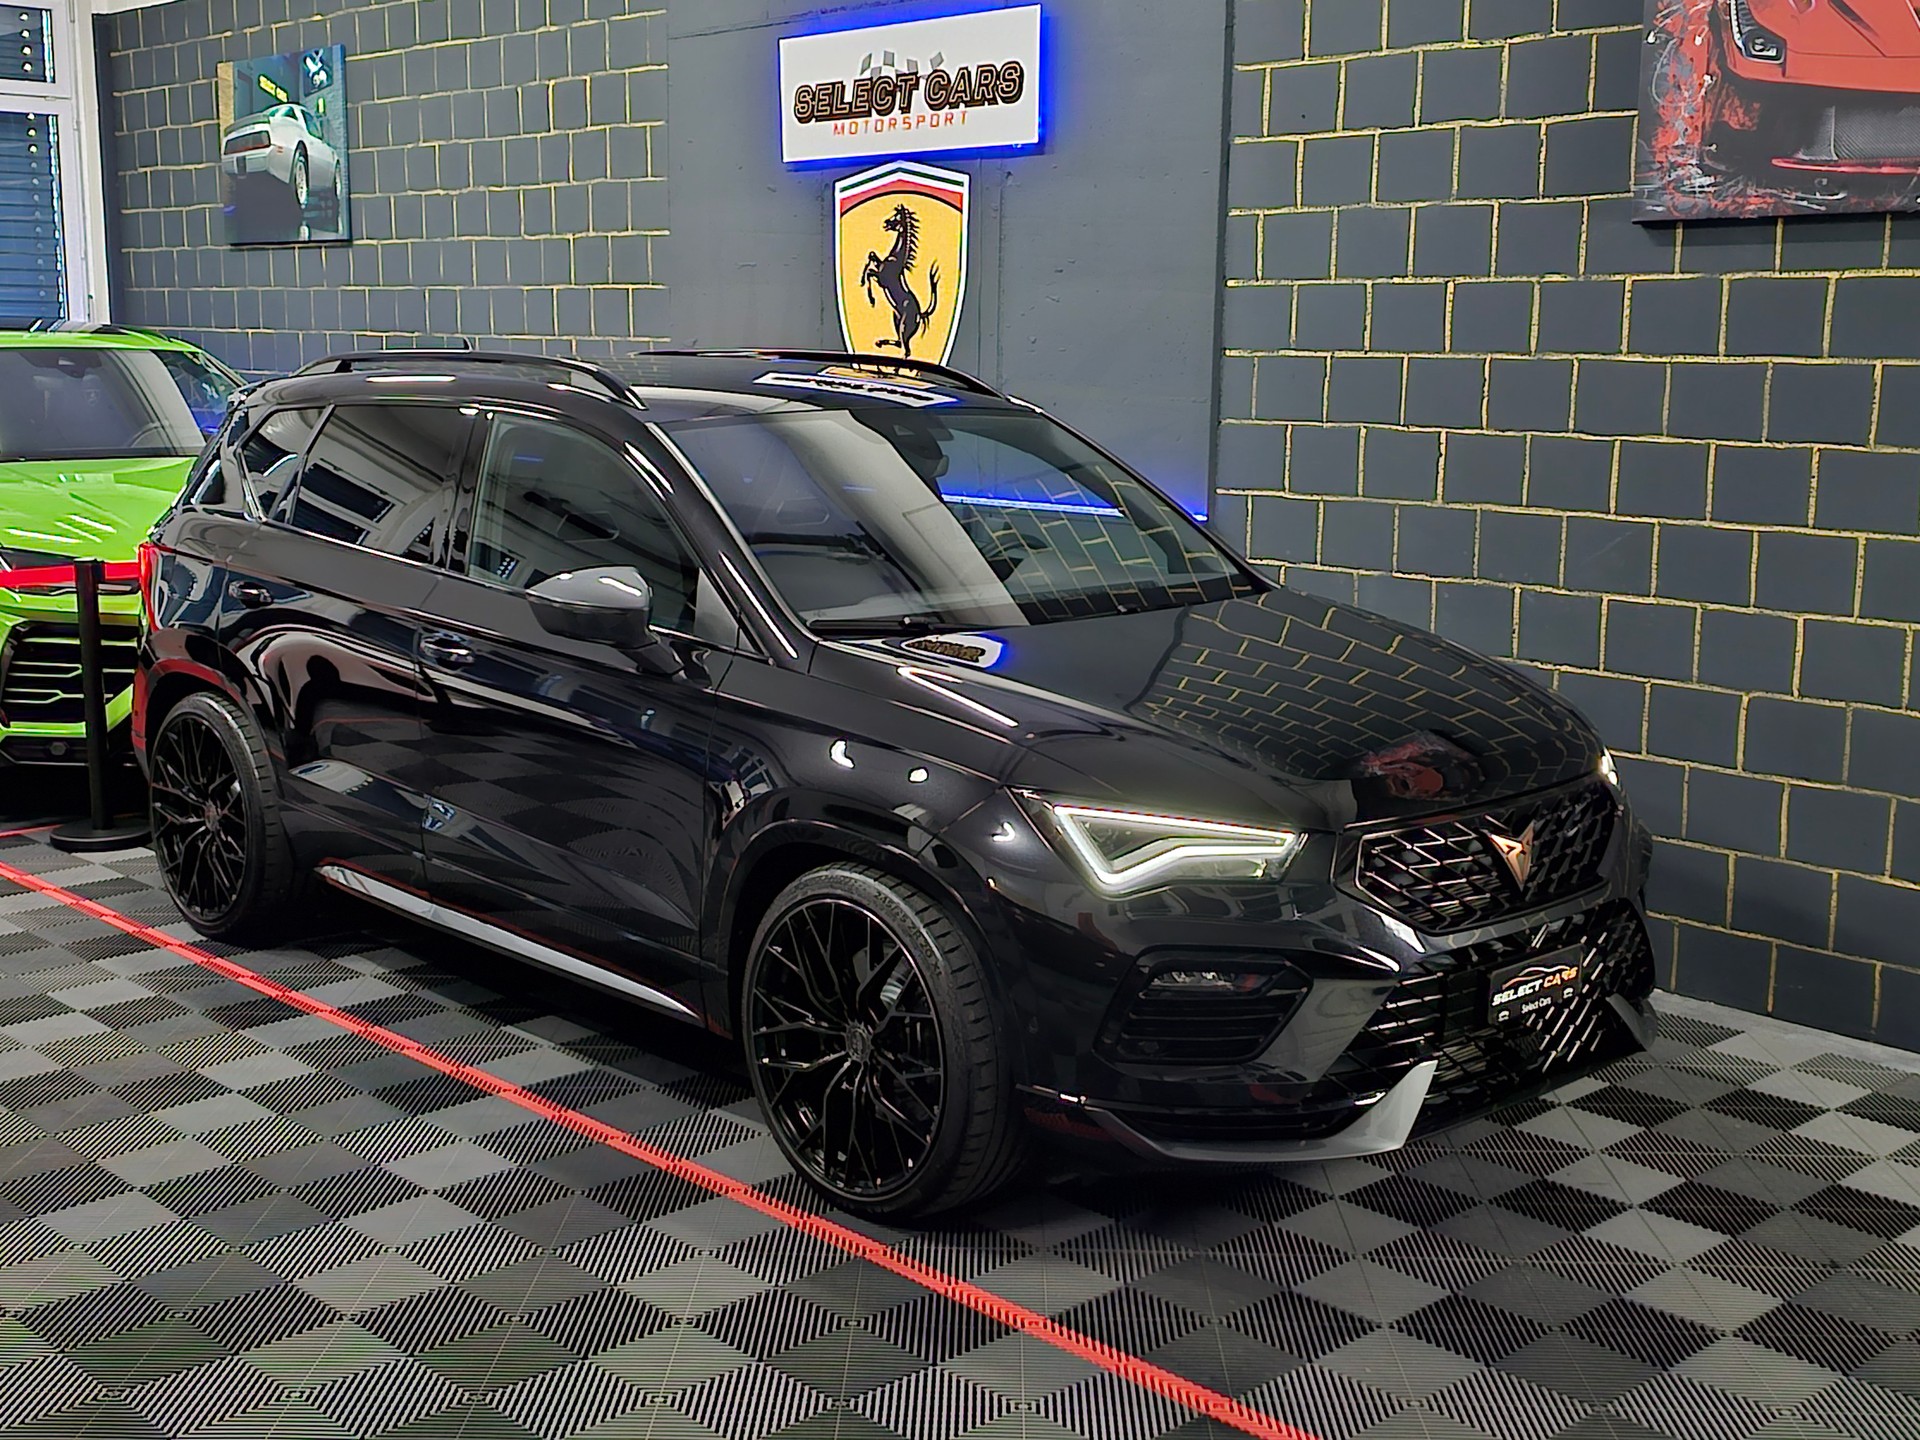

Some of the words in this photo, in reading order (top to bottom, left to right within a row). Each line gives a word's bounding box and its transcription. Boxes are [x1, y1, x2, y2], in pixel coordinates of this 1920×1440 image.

[794, 76, 918, 124] SELECT
[924, 60, 1024, 111] CARS
[833, 111, 968, 135] MOTORSPORT
[1492, 980, 1543, 1006] SELECT
[1543, 967, 1578, 988] CARS
